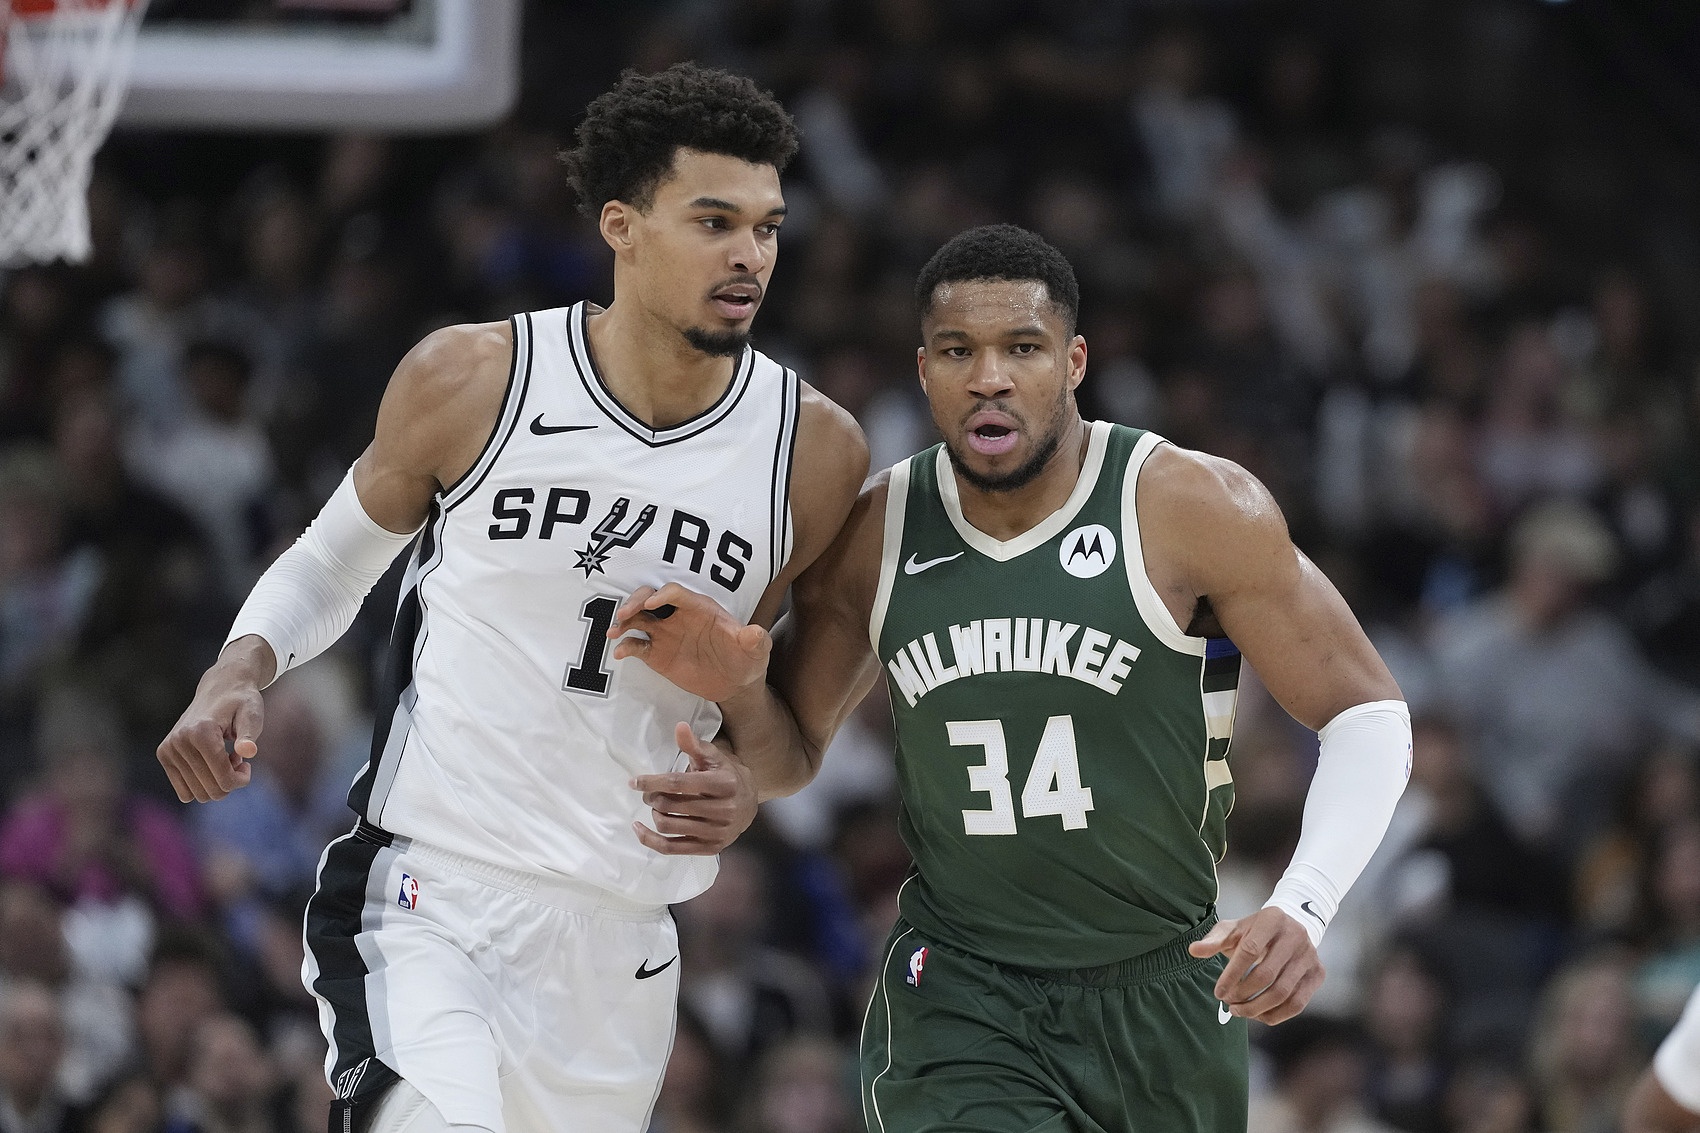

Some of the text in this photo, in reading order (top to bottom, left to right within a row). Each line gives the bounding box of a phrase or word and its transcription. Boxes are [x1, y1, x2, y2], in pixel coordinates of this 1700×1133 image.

[487, 486, 754, 593] SPURS
[561, 592, 623, 699] 1
[887, 617, 1142, 708] MILWAUKEE
[945, 714, 1095, 836] 34
